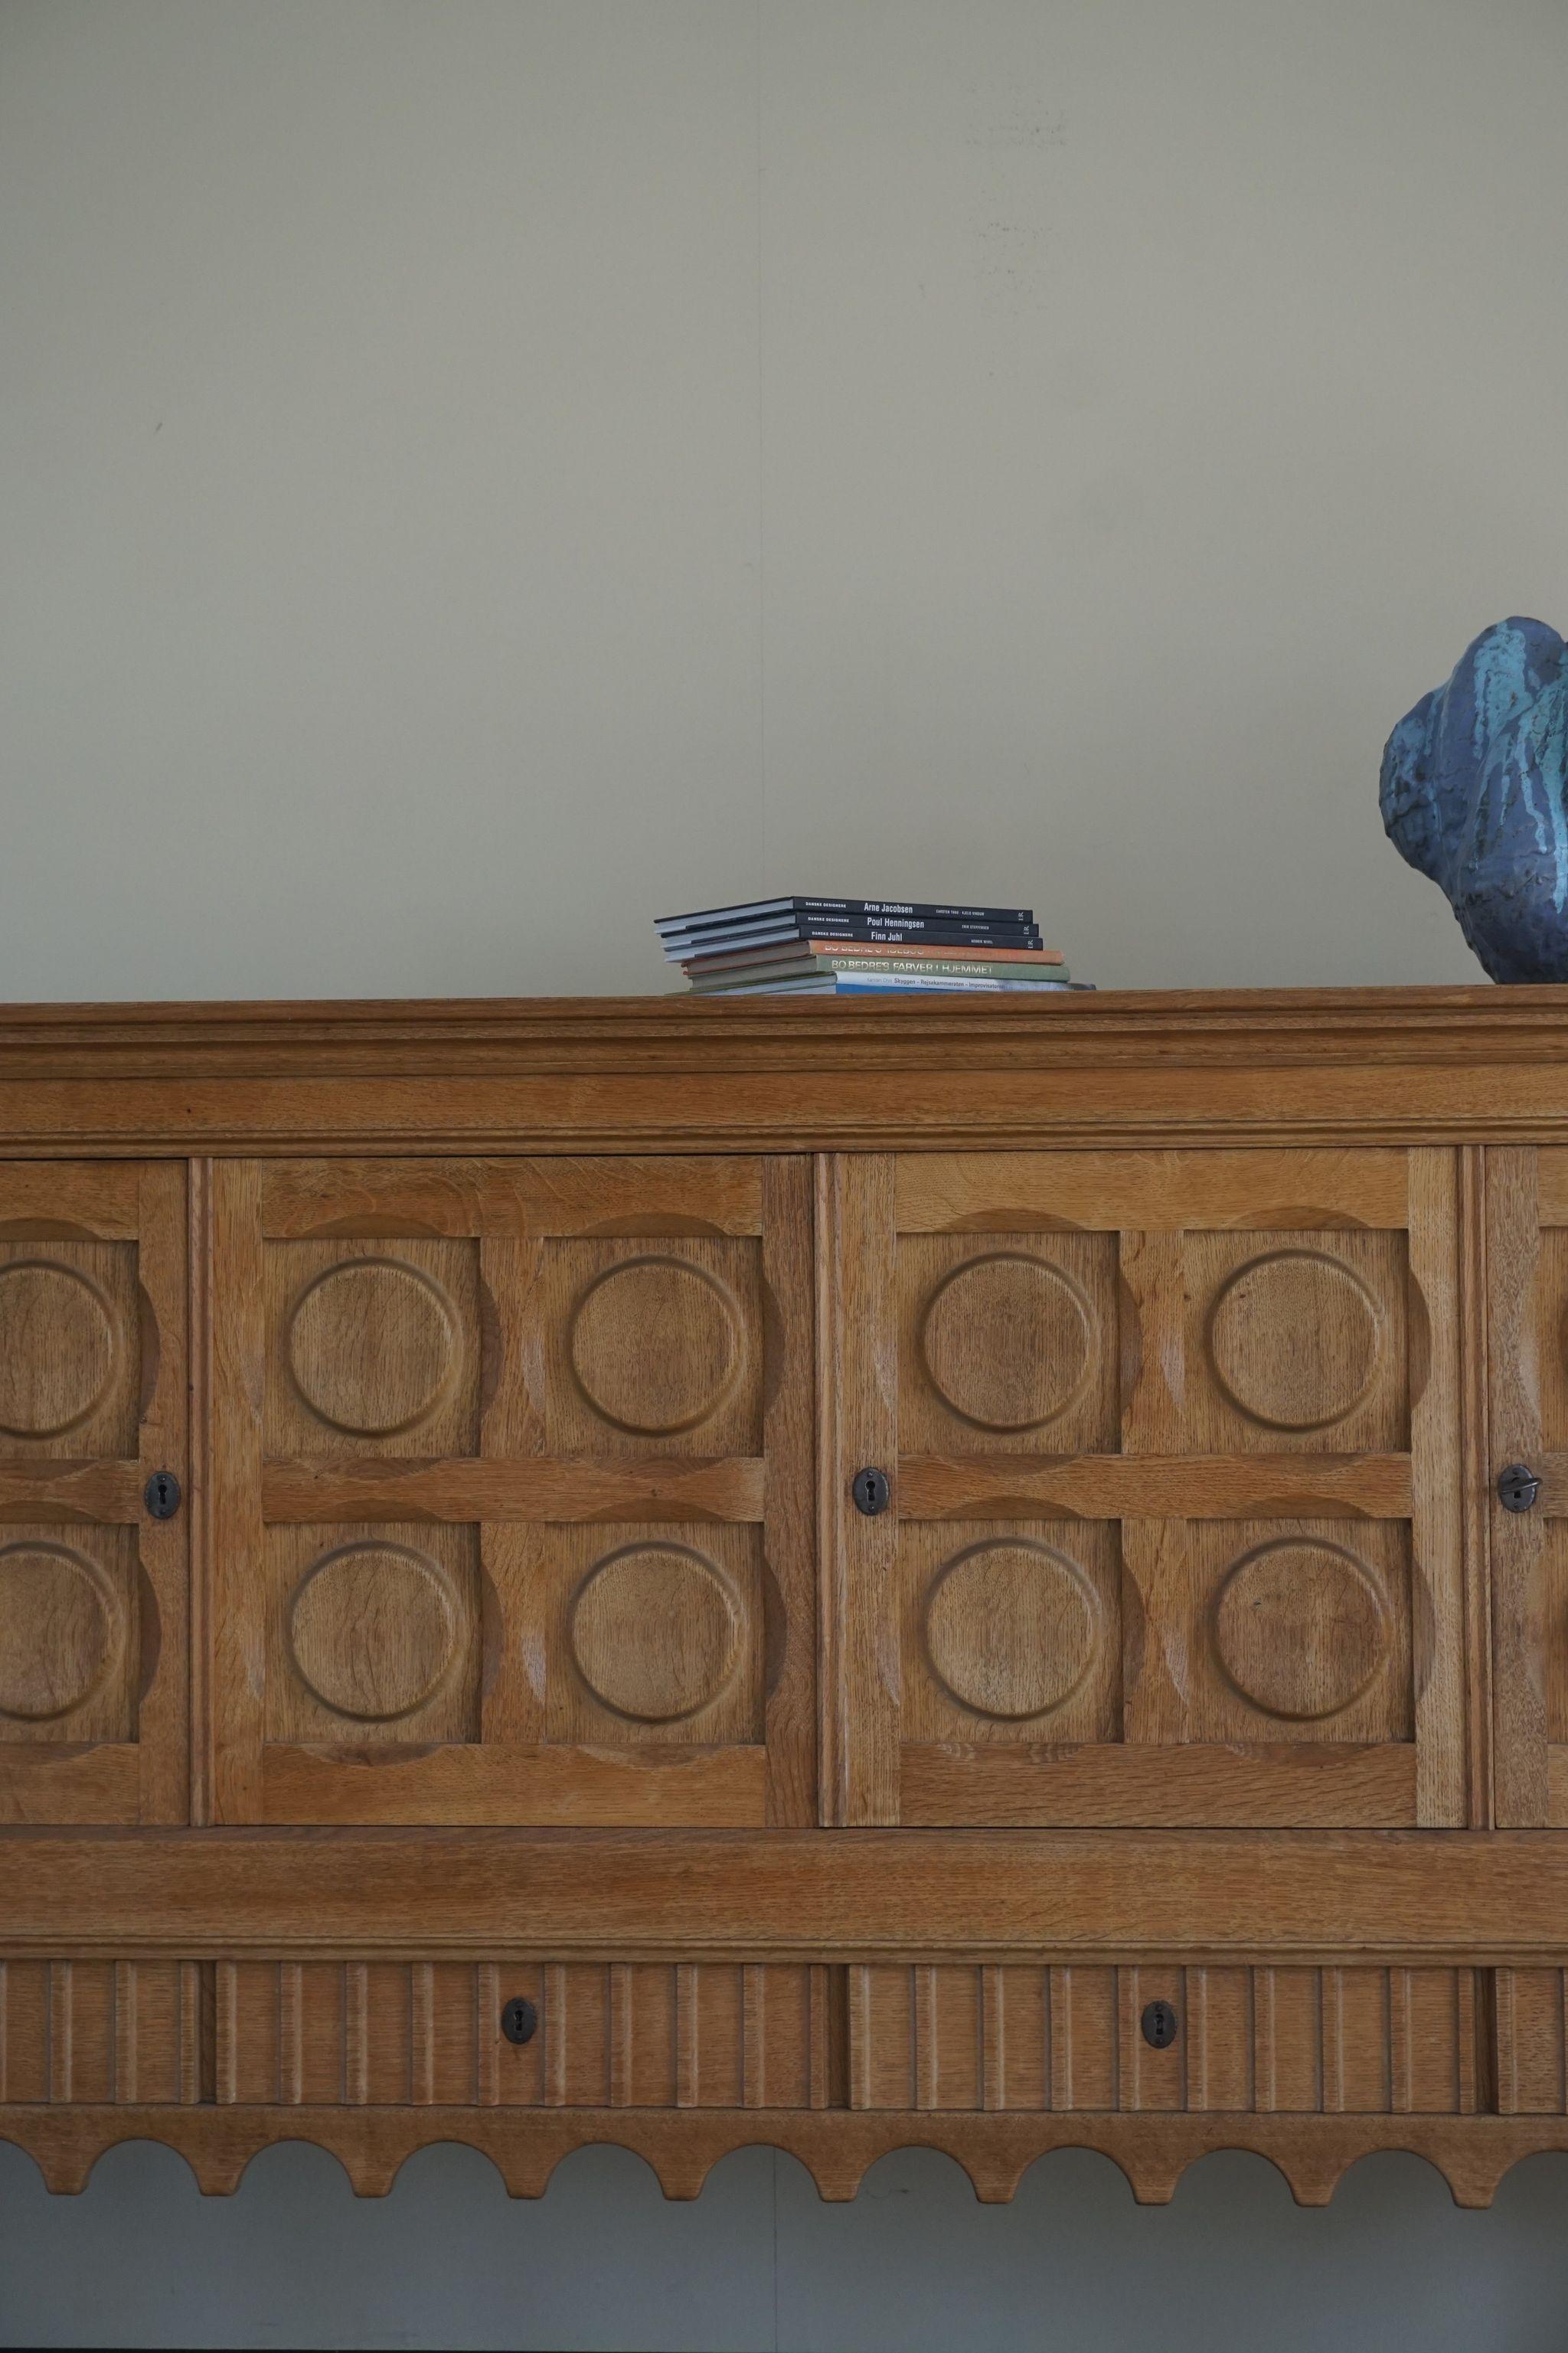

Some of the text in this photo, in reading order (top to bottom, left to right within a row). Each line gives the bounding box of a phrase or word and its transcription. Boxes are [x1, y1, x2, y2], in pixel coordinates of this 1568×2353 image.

[864, 903, 913, 913] Arne Jacobsen
[867, 917, 925, 930] Poul Henningsen
[871, 932, 903, 942] Finn Juhl
[831, 960, 847, 969] BO
[848, 960, 890, 971] BEDRE'S
[893, 963, 933, 973] FARVER
[942, 965, 992, 974] HJEMMET
